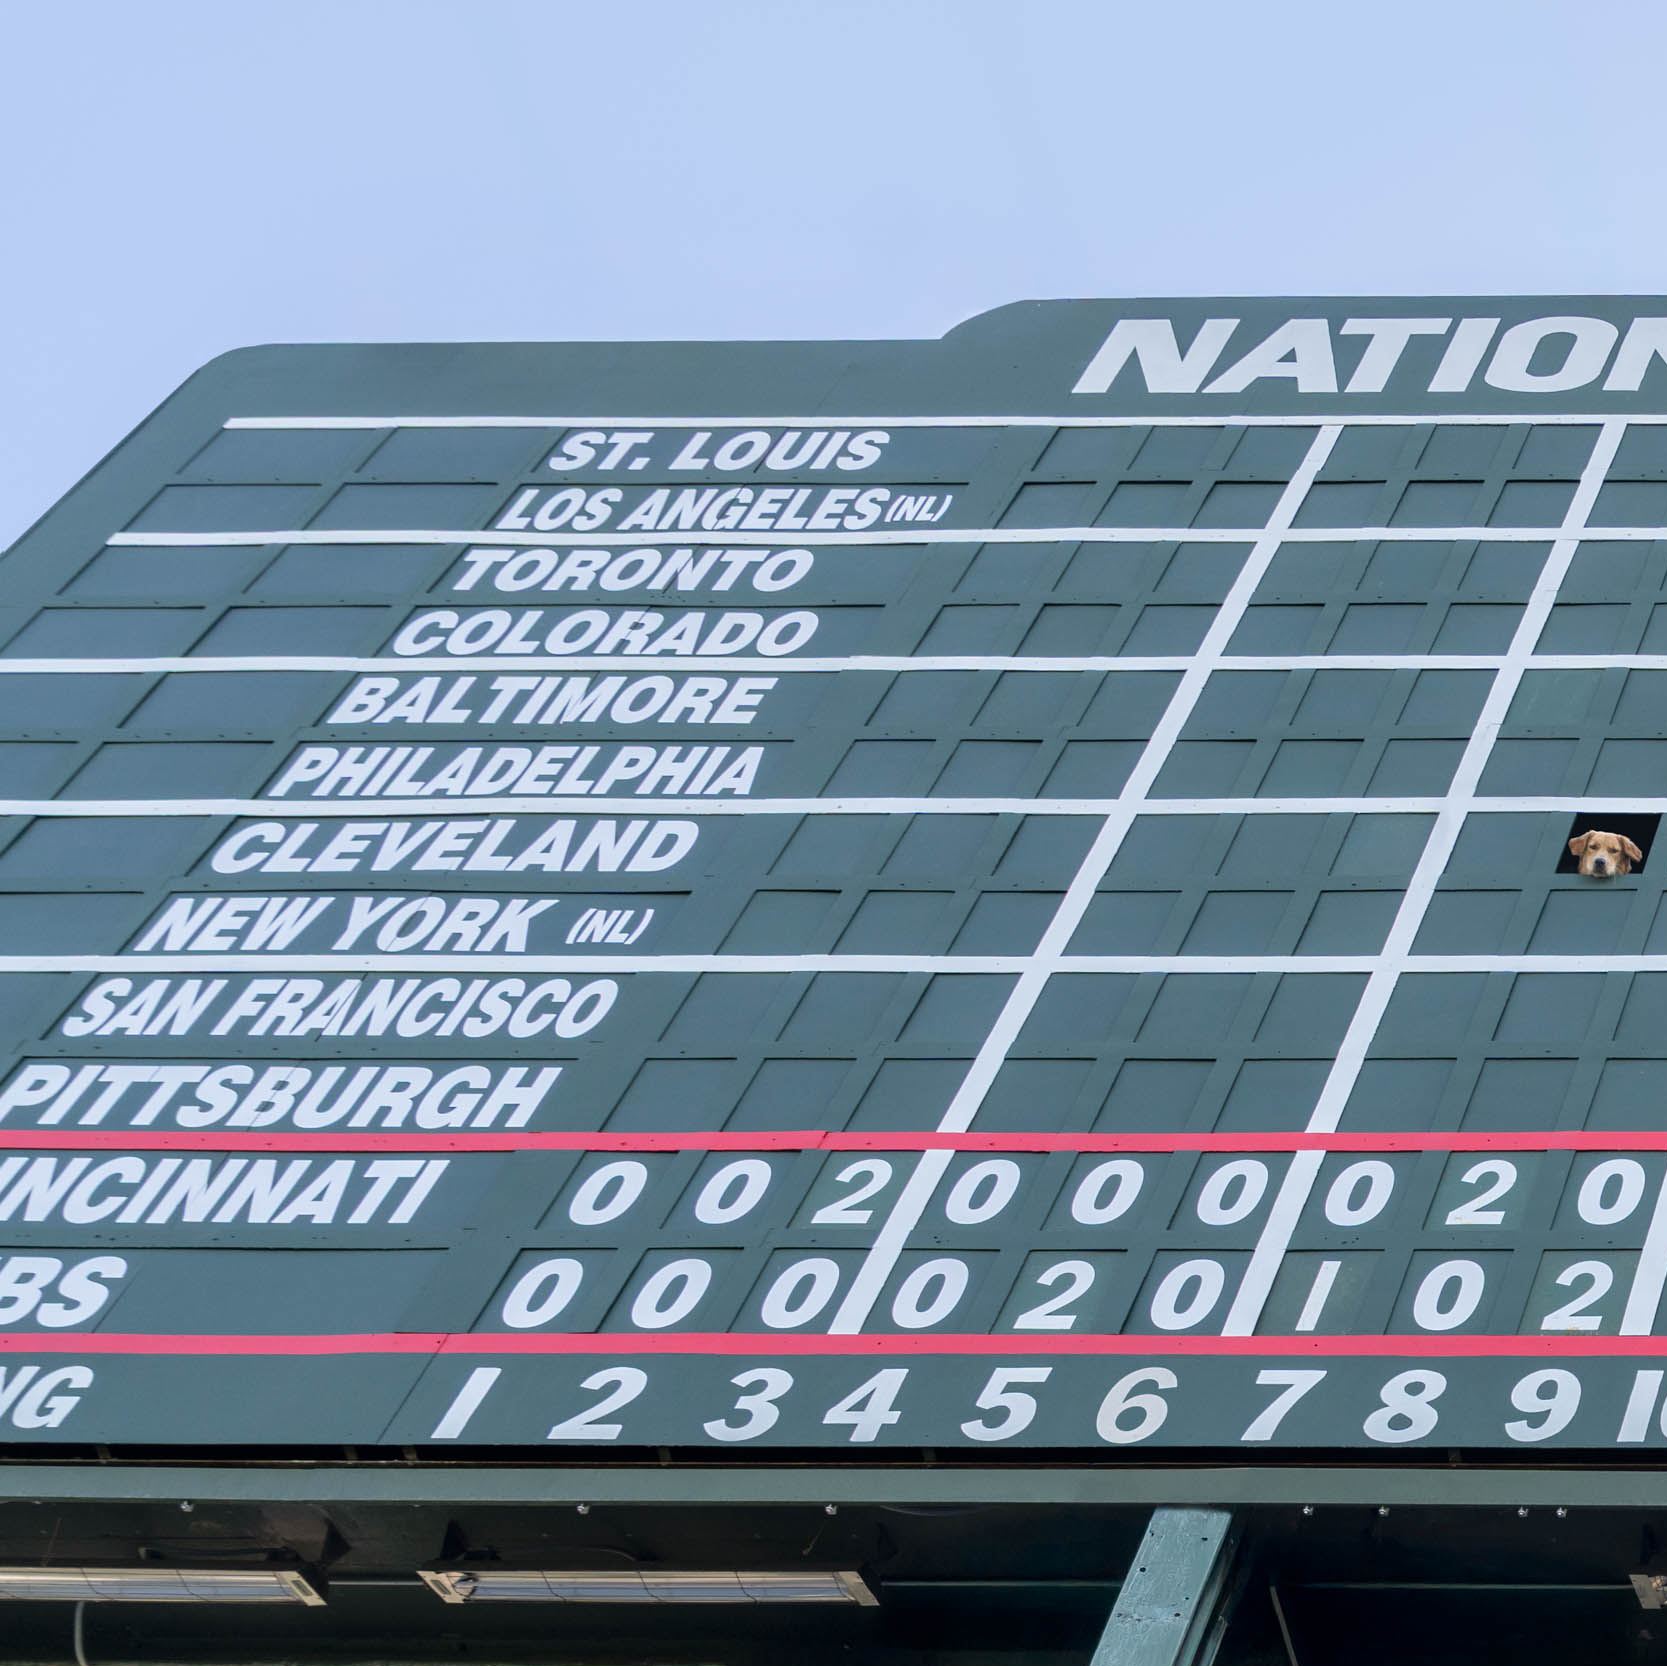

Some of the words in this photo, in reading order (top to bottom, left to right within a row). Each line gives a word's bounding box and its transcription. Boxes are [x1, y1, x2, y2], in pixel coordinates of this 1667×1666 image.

[549, 432, 654, 470] ST.
[669, 431, 889, 470] LOUIS
[496, 488, 612, 530] LOS
[453, 549, 814, 591] TORONTO
[394, 610, 818, 656] COLORADO
[327, 676, 778, 724] BALTIMORE
[268, 746, 764, 796] PHILADELPHIA
[212, 820, 699, 873] CLEVELAND
[134, 897, 335, 951] NEW
[332, 897, 559, 952] YORK
[566, 908, 654, 944] (NL)
[63, 978, 228, 1036] SAN
[210, 978, 618, 1038] FRANCISCO
[0, 1065, 562, 1129] PITTSBURGH
[569, 1161, 647, 1225] 0
[695, 1159, 771, 1224] 0
[811, 1159, 892, 1223] 2
[946, 1160, 1020, 1224] 0
[1072, 1160, 1144, 1224] 0
[1197, 1160, 1268, 1225] 0
[1325, 1161, 1394, 1226] 0
[1445, 1160, 1517, 1224] 2
[1578, 1159, 1645, 1225] 0
[502, 1259, 583, 1328] 0
[632, 1259, 711, 1328] 0
[761, 1258, 839, 1328] 0
[892, 1259, 968, 1328] 0
[1013, 1261, 1095, 1329] 2
[1151, 1260, 1224, 1330] 0
[1295, 1261, 1341, 1331] 1
[1414, 1260, 1484, 1330] 0
[1540, 1261, 1613, 1330] 2
[431, 1368, 501, 1438] 1
[547, 1367, 647, 1439] 2
[704, 1368, 793, 1441] 3
[823, 1369, 909, 1441] 4
[961, 1367, 1052, 1441] 5
[1097, 1367, 1177, 1443] 6
[1241, 1370, 1327, 1440] 7
[1363, 1370, 1447, 1443] 8
[1505, 1369, 1581, 1441] 9
